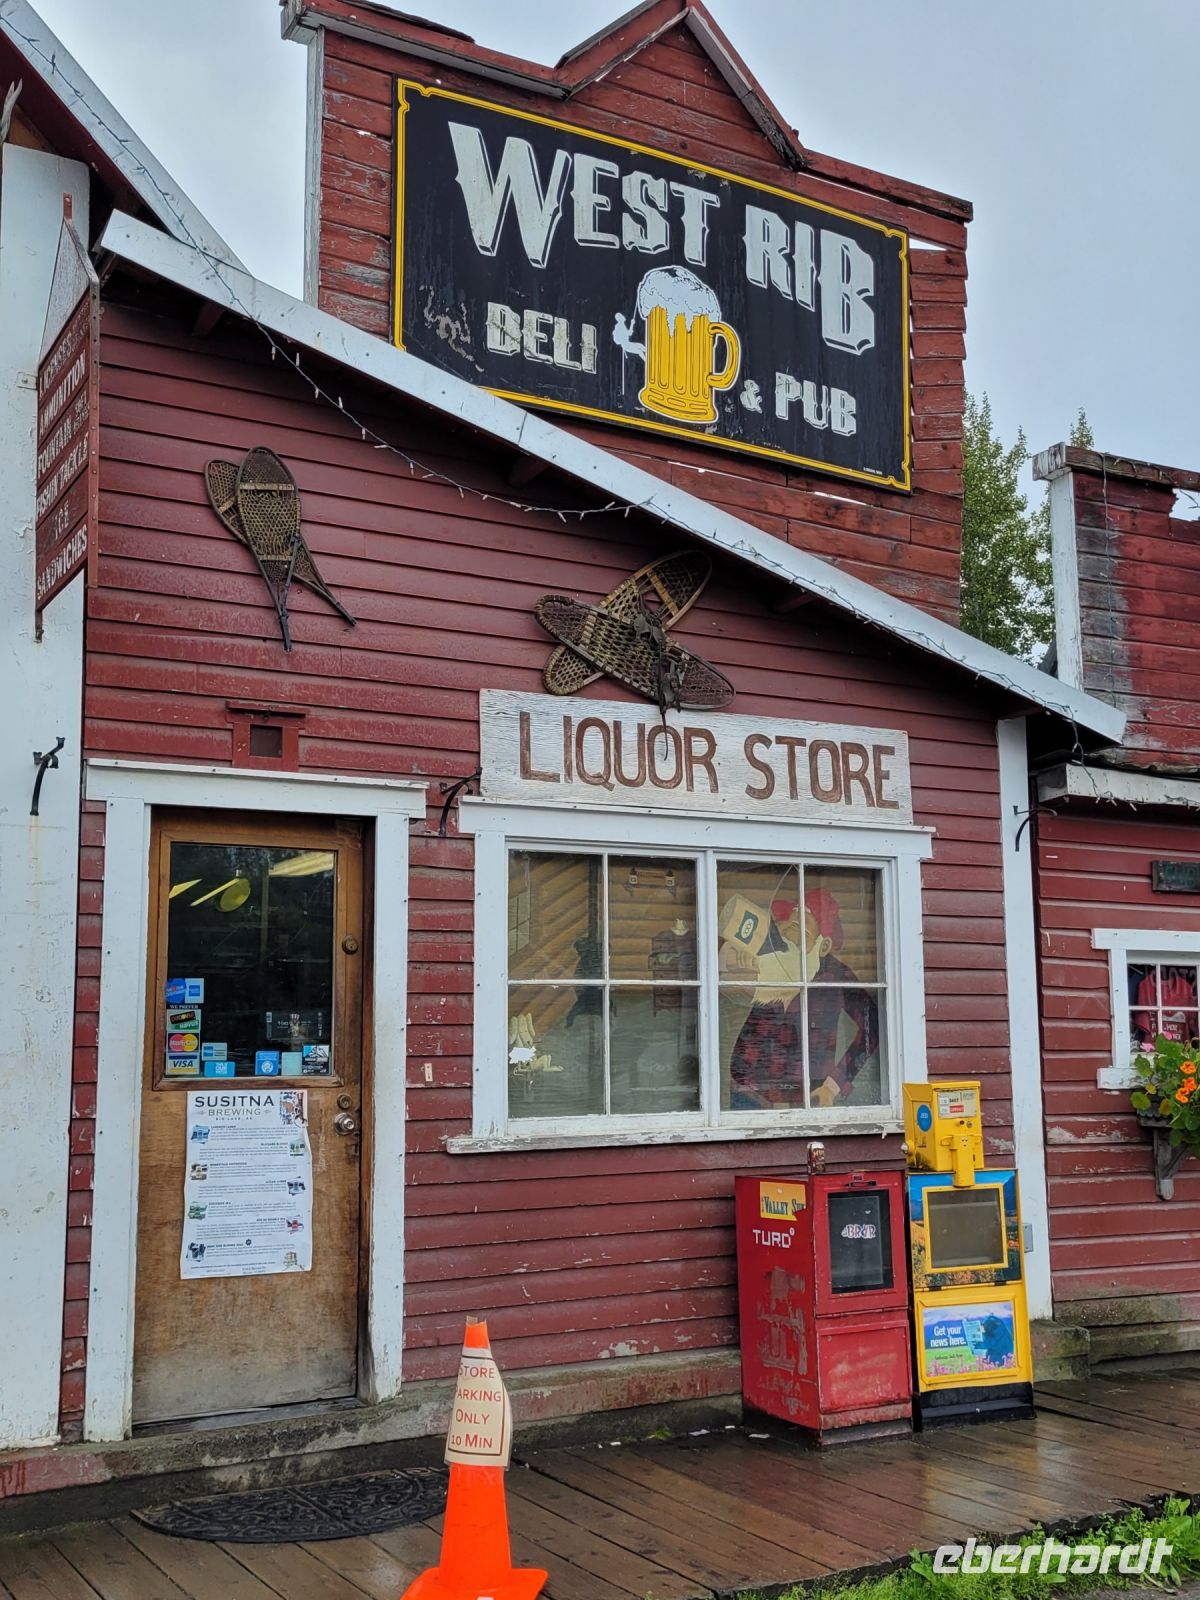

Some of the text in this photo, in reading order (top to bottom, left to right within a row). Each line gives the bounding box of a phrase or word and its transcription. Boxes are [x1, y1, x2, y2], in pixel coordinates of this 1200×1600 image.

[449, 121, 875, 355] WEST RIB
[486, 301, 598, 374] DELI
[39, 348, 86, 439] AMMUNITION
[740, 372, 857, 436] & PUB
[38, 414, 73, 479] FOUNTAIN
[59, 431, 88, 492] TACKLE
[37, 523, 88, 601] SANDWICHES
[519, 711, 900, 809] LIQUOR STORE
[173, 1060, 194, 1068] VISA
[194, 1095, 275, 1107] SUSITNA
[208, 1108, 261, 1116] BREWING
[764, 1196, 789, 1216] VALLEY
[930, 1335, 967, 1348] news here.
[933, 1325, 962, 1338] Get your
[455, 1386, 502, 1402] ARKING
[455, 1408, 490, 1425] ONLY
[451, 1433, 493, 1449] 10 MIN
